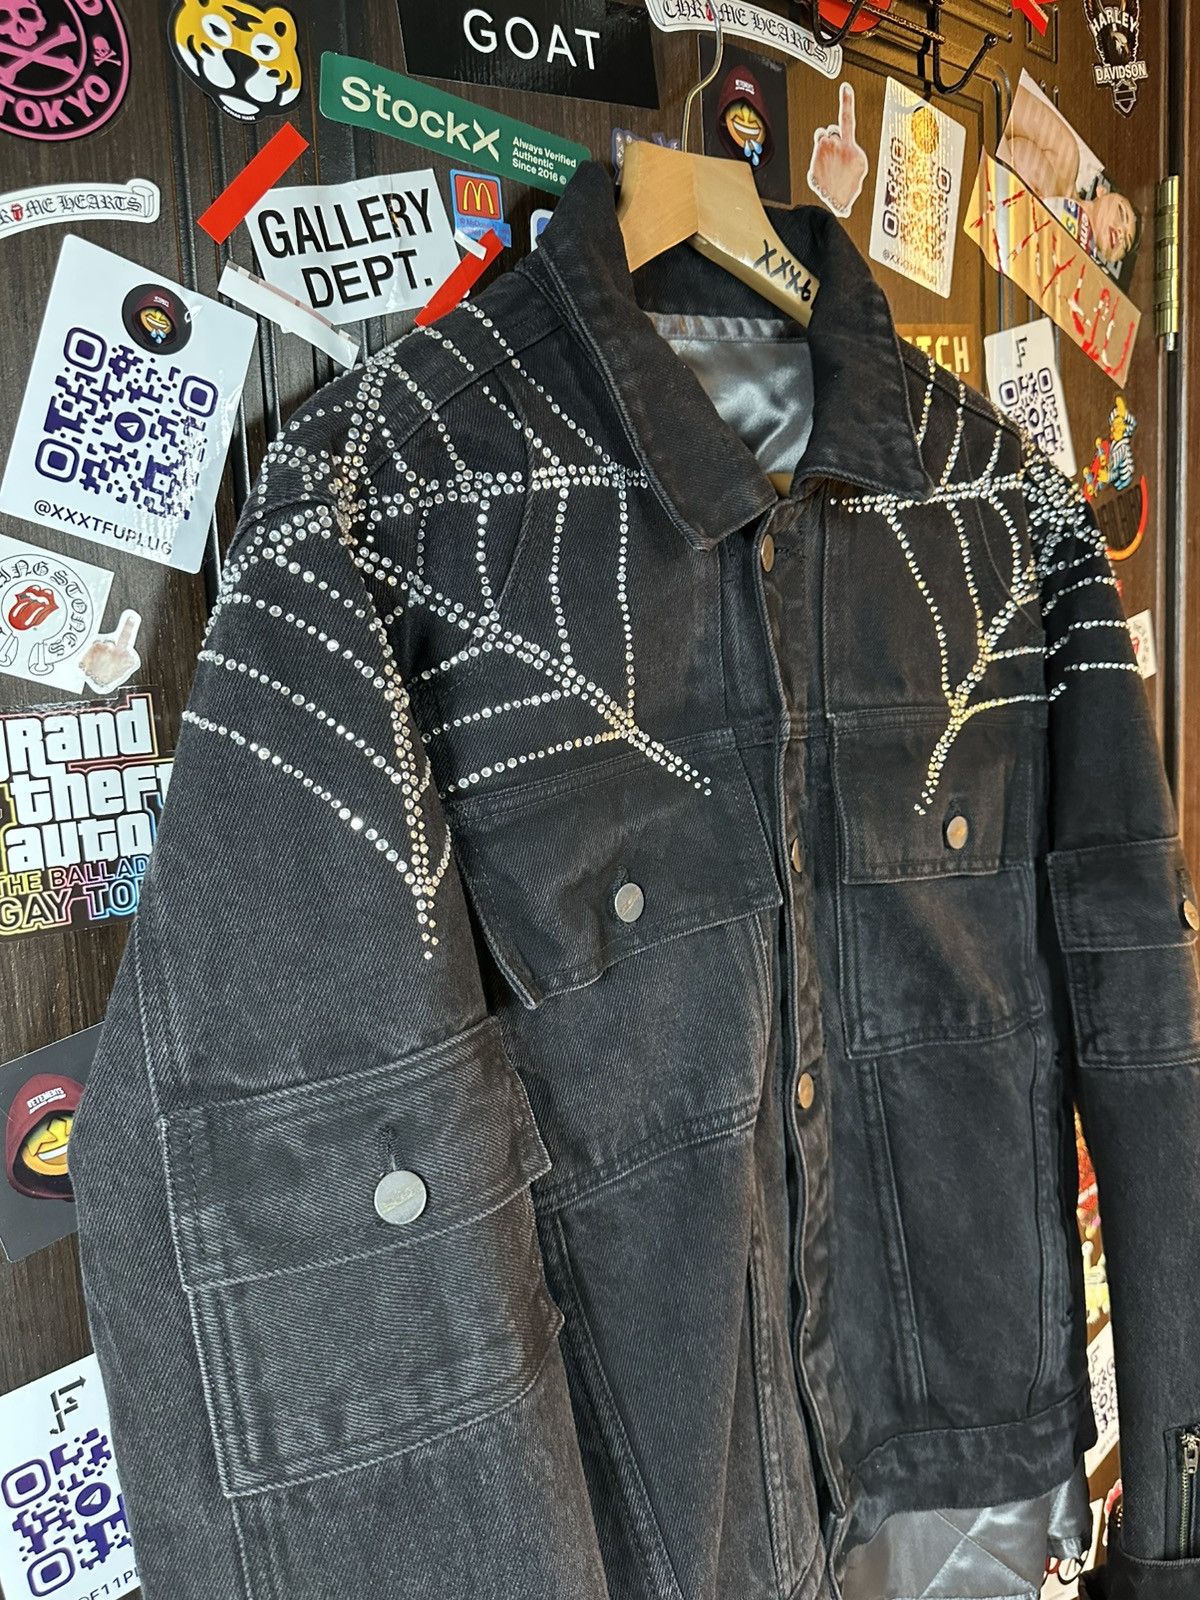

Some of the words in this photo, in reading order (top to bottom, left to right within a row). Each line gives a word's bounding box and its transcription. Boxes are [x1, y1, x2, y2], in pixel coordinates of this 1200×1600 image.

[463, 8, 600, 70] GOAT
[751, 10, 828, 65] HEARTS
[1089, 7, 1139, 37] HARLEY
[1094, 62, 1148, 83] DAVIDSON
[0, 75, 110, 128] TOKYO
[341, 76, 500, 162] StockX
[512, 136, 543, 155] Always
[544, 147, 577, 168] Verified
[512, 147, 554, 170] Authentic
[512, 158, 537, 175] Since
[537, 167, 559, 182] 2016
[57, 193, 143, 214] HEARTS
[258, 188, 430, 258] GALLERY
[301, 249, 434, 309] DEPT.
[903, 335, 970, 374] TCH
[34, 499, 173, 556] @XXXTFUPLUG
[0, 559, 49, 588] ING
[49, 854, 150, 890] BALLAD
[0, 888, 72, 935] GAY
[84, 877, 144, 920] TO
